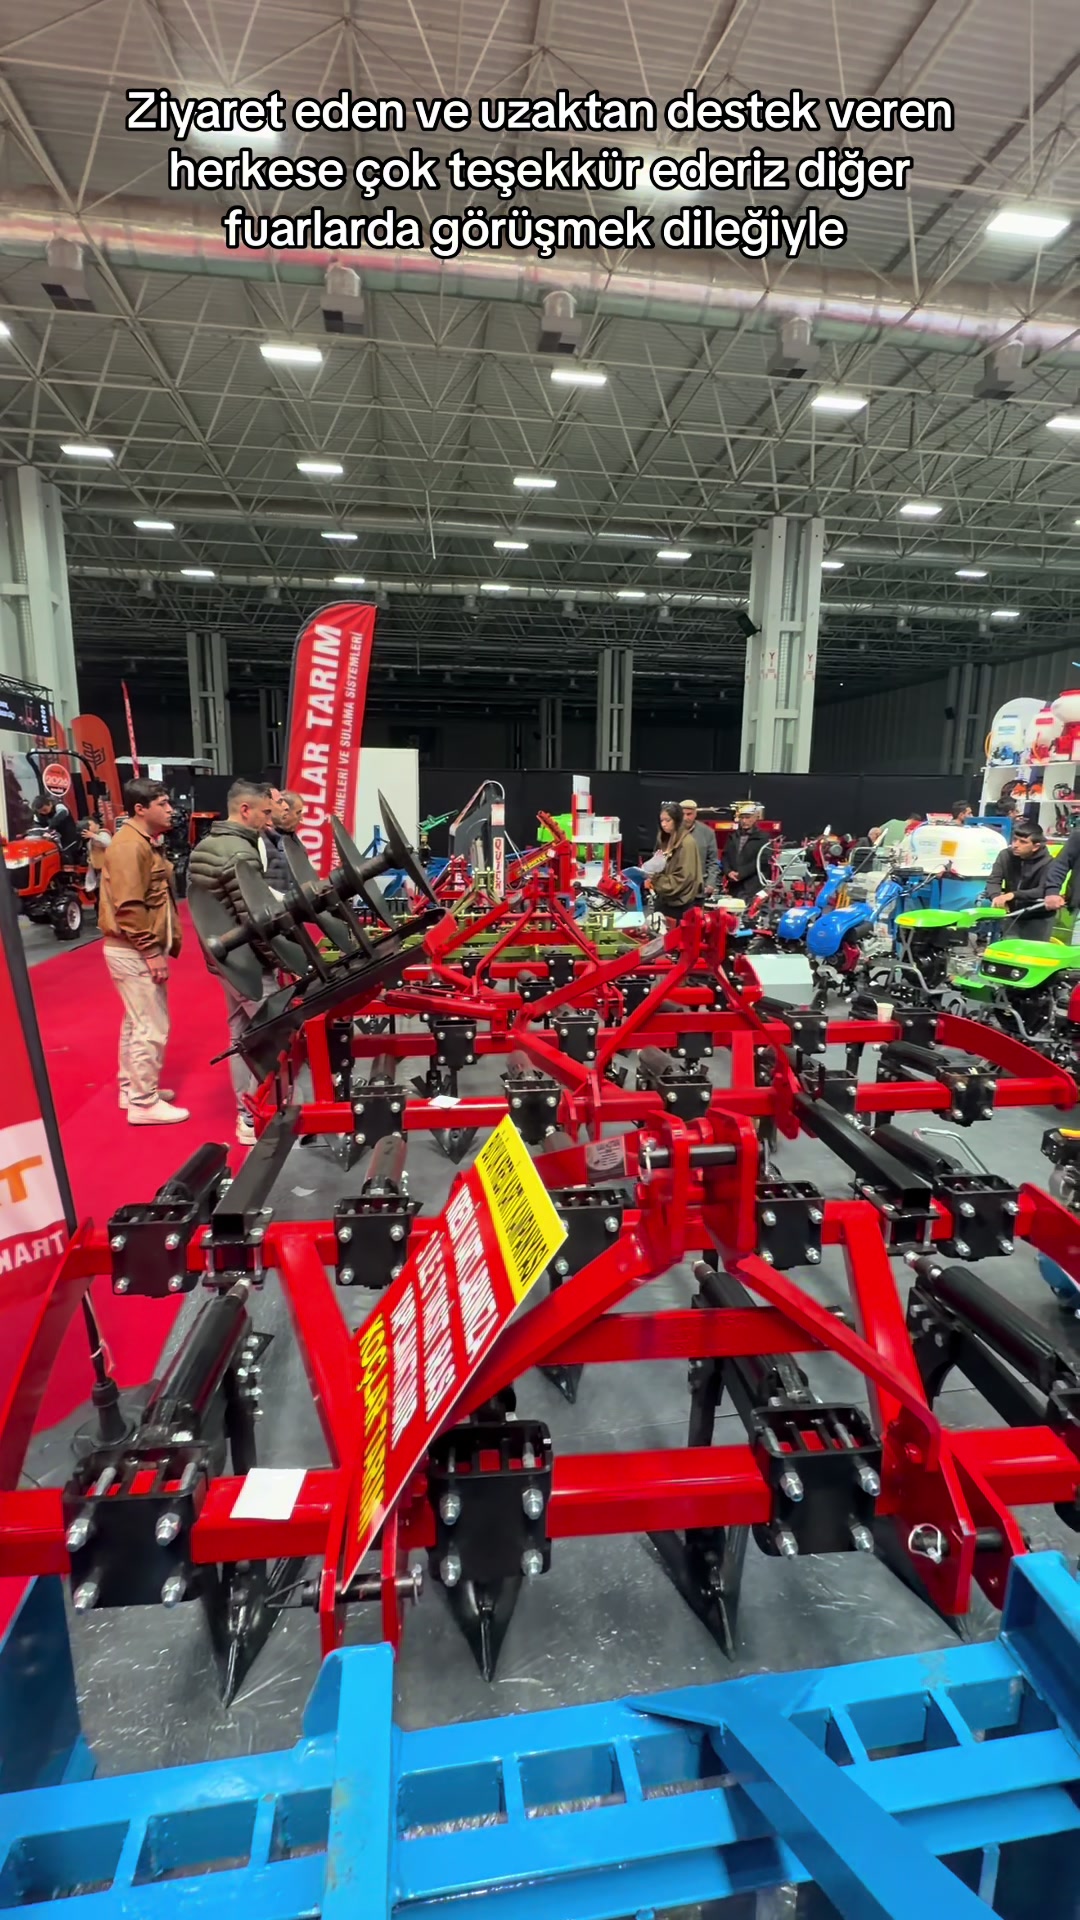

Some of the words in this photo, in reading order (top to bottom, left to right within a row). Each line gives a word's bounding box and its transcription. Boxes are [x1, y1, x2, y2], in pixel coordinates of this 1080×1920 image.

[307, 624, 342, 729] TARIM
[346, 633, 363, 698] SİSTEMLERİ
[341, 701, 355, 747] SULAMA
[338, 751, 350, 764] VE
[334, 768, 349, 824] AKİNELERİ
[481, 1129, 509, 1175] BÜYÜK
[489, 1151, 519, 1199] KREDİ
[445, 1182, 480, 1246] KREDİ
[496, 1171, 524, 1223] KARTI
[417, 1232, 443, 1290] İLE
[504, 1194, 548, 1287] KAMPANYASI
[421, 1272, 453, 1358] TAKSİT
[452, 1217, 498, 1366] KARTLARINIZA
[356, 1310, 388, 1435] KOÇLAR
[389, 1280, 419, 1449] YAPILMAKTADIR
[423, 1327, 455, 1423] ARASI
[357, 1408, 388, 1544] TARIM
